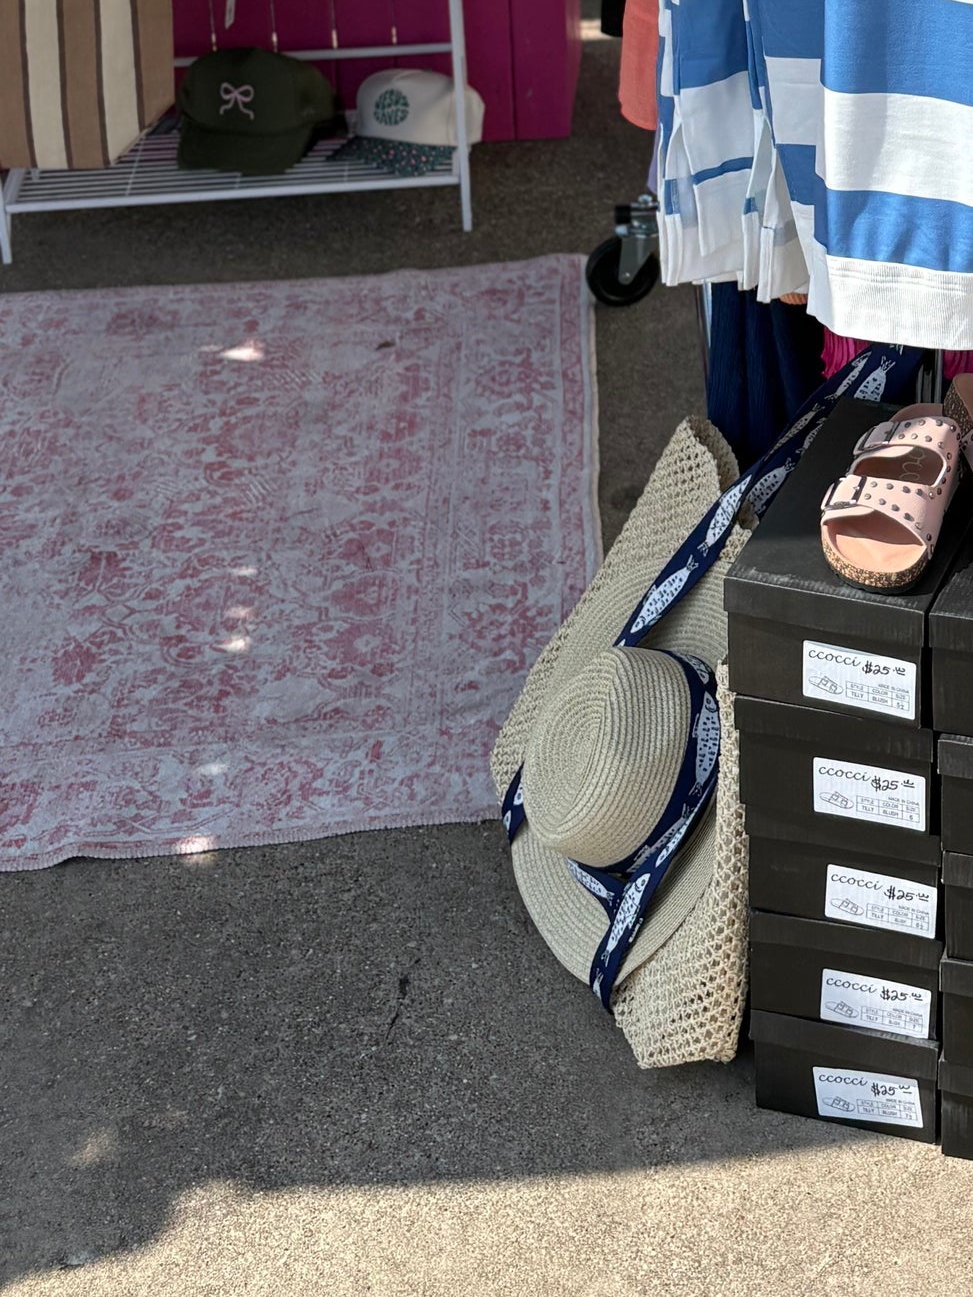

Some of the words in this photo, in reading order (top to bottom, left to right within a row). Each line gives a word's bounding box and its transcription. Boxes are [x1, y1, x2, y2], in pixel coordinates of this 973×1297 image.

[374, 108, 409, 126] SAVES
[808, 649, 862, 667] ccocci
[818, 766, 872, 782] ccocci
[831, 873, 883, 891] ccocci
[826, 977, 878, 994] ccocci
[818, 1074, 868, 1087] ccocci
